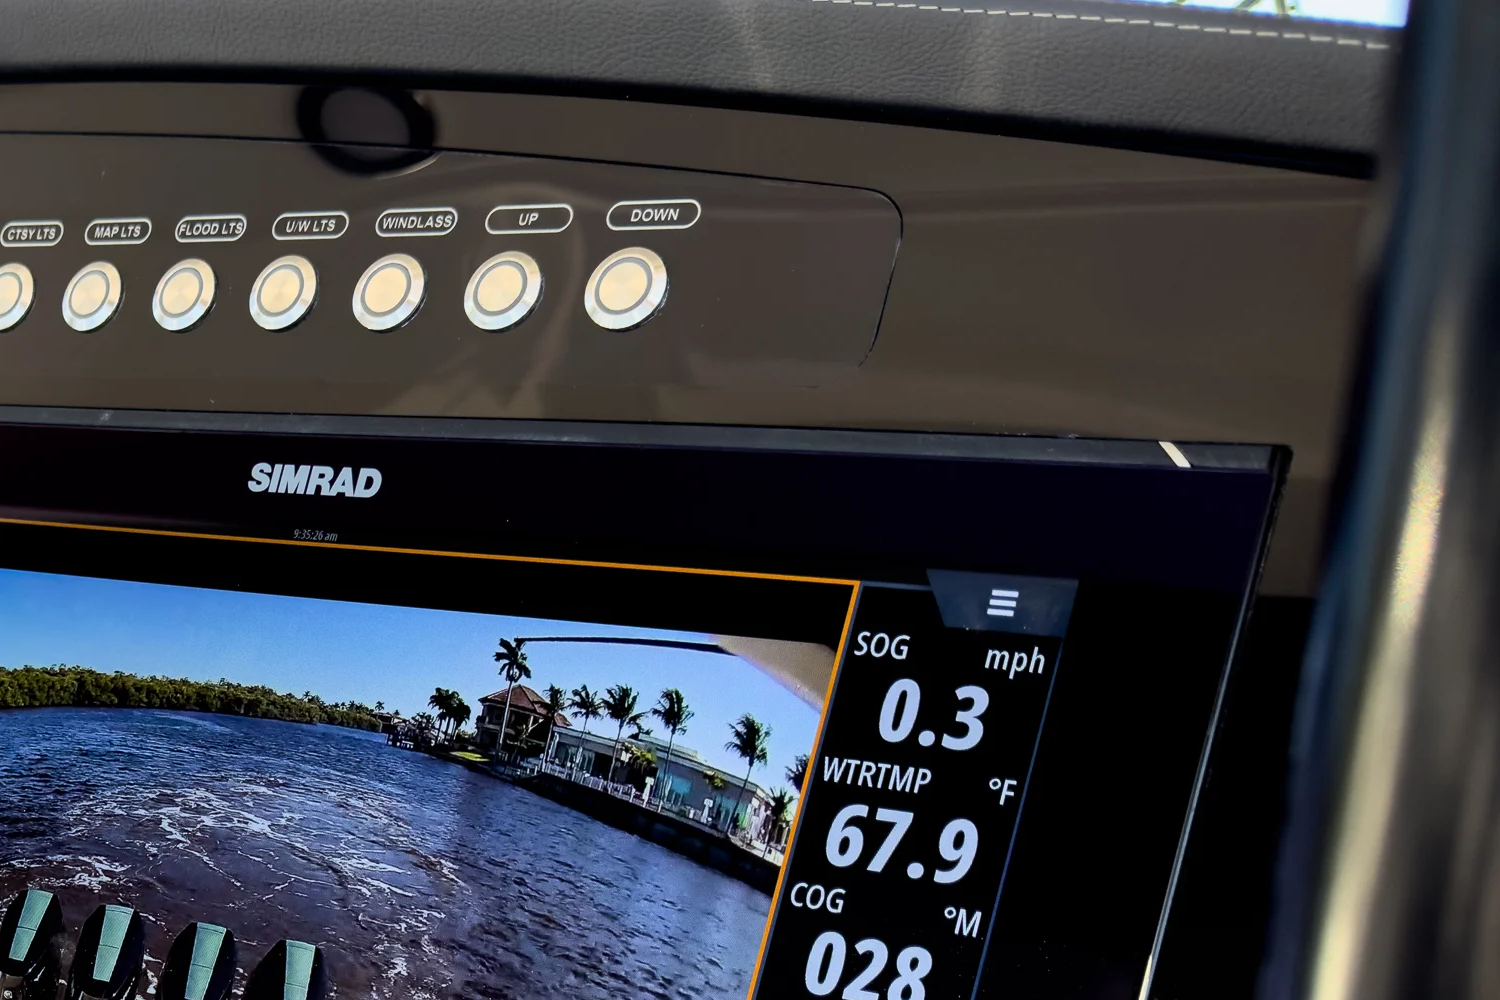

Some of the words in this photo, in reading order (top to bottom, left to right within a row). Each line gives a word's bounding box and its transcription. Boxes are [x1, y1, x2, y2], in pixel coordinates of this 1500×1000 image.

[177, 223, 215, 237] FLOOD
[215, 221, 244, 235] LTS
[285, 219, 311, 233] U/W
[312, 218, 336, 232] LTS
[381, 214, 454, 230] WINDLASS
[518, 212, 539, 226] UP
[629, 208, 680, 223] DOWN
[6, 228, 32, 241] CTSY
[32, 226, 56, 240] LTS
[94, 225, 119, 240] MAP
[119, 224, 142, 238] LTS
[247, 462, 383, 498] SIMRAD
[293, 528, 324, 541] 9:35:26
[324, 532, 339, 542] am
[853, 631, 911, 660] SOG
[984, 646, 1046, 679] mph
[878, 678, 990, 751] 0.3
[823, 756, 932, 794] WTRTMP
[989, 777, 1017, 805] °F
[825, 803, 979, 884] 67.9
[790, 882, 847, 914] COG
[943, 906, 982, 938] °M
